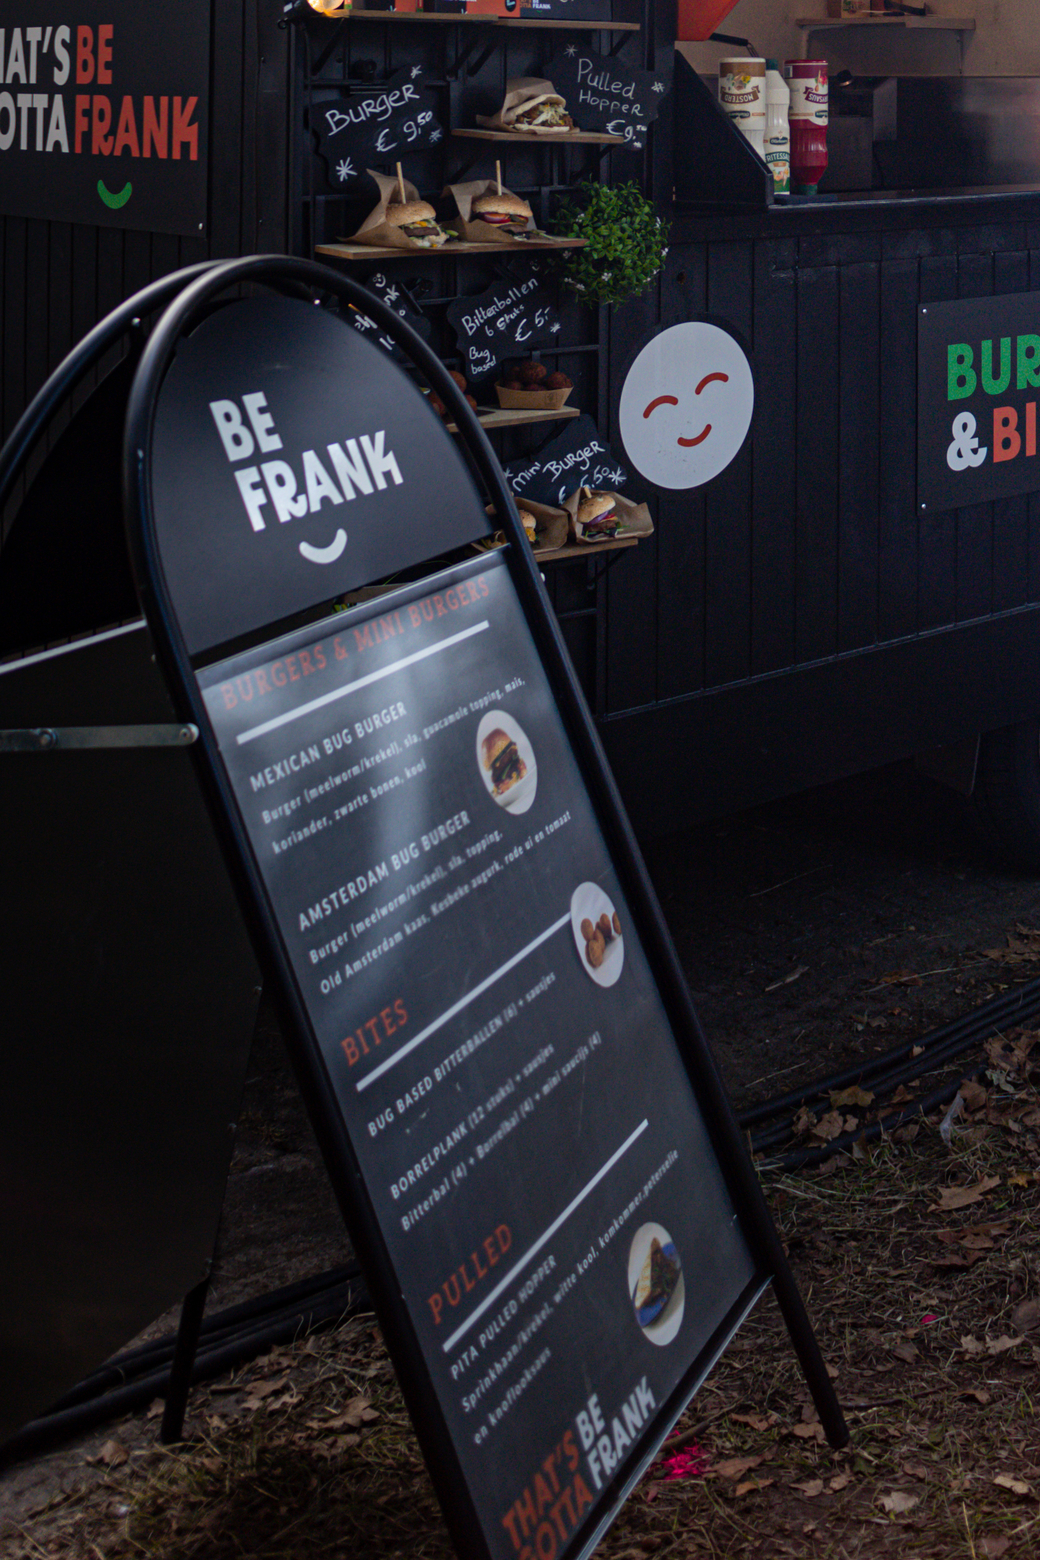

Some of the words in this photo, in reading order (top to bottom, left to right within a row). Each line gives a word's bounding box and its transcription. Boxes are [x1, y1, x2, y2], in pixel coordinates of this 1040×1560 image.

[76, 24, 113, 84] BE
[578, 58, 635, 98] Pulled
[75, 95, 198, 160] FRANK
[375, 129, 397, 151] €
[403, 111, 433, 141] 9,50
[469, 347, 490, 361] Bug
[471, 356, 496, 374] based
[485, 326, 493, 337] 6
[515, 319, 532, 341] €
[209, 391, 283, 462] BE
[234, 430, 403, 532] FRANK
[220, 646, 327, 710] BURGERS
[334, 637, 348, 660] &
[353, 612, 404, 652] MINI
[408, 577, 490, 628] BURGERS
[250, 744, 320, 792] MEXICAN
[323, 729, 352, 754] BUG
[354, 702, 407, 738] BURGER
[262, 794, 301, 824] Burger
[404, 732, 421, 748] sla,
[423, 707, 469, 739] guacamole
[470, 690, 503, 713] topping,
[504, 676, 525, 693] mais,
[272, 815, 333, 854] koriander,
[334, 794, 369, 820] zwarte
[370, 774, 404, 799] bonen,
[404, 758, 426, 779] kool
[299, 862, 389, 931] AMSTERDAM
[391, 843, 420, 871] BUG
[420, 811, 471, 851] BURGER
[309, 930, 349, 964] Burger
[466, 830, 502, 858] topping,
[320, 970, 342, 994] Old
[344, 930, 403, 979] Amsterdam
[404, 913, 431, 936] kaas,
[431, 883, 469, 916] Kesbeke
[471, 860, 503, 889] augurk,
[504, 845, 523, 866] rode
[525, 837, 534, 851] ui
[535, 829, 544, 843] en
[545, 811, 571, 835] tomaat
[341, 999, 407, 1067] BITES
[367, 1108, 394, 1137] BUG
[396, 1077, 433, 1114] BASED
[434, 1014, 503, 1082] BITTERBALLEN
[503, 1003, 519, 1023] (6)
[525, 972, 556, 1003] sausjes
[390, 1121, 468, 1200] BORRELPLANK
[468, 1106, 485, 1129] (12
[486, 1078, 516, 1112] stuks)
[522, 1044, 554, 1077] sausjes
[401, 1177, 450, 1231] Bitterbal
[451, 1162, 468, 1185] (4)
[468, 1157, 475, 1165] +
[476, 1111, 519, 1159] Borrelbal
[520, 1098, 534, 1119] (4)
[542, 1071, 561, 1095] mini
[561, 1046, 588, 1077] saucijs
[588, 1031, 602, 1050] (4)
[428, 1224, 512, 1326] PULLED
[450, 1346, 478, 1380] PITA
[479, 1300, 518, 1348] PULLED
[519, 1254, 557, 1304] HOPPER
[553, 1275, 577, 1303] witte
[577, 1250, 599, 1275] kool,
[474, 1426, 488, 1444] en
[488, 1347, 551, 1427] knoflooksaus
[587, 1375, 656, 1490] FRANK
[502, 1430, 579, 1550] THAT'S
[576, 1393, 605, 1451] BE
